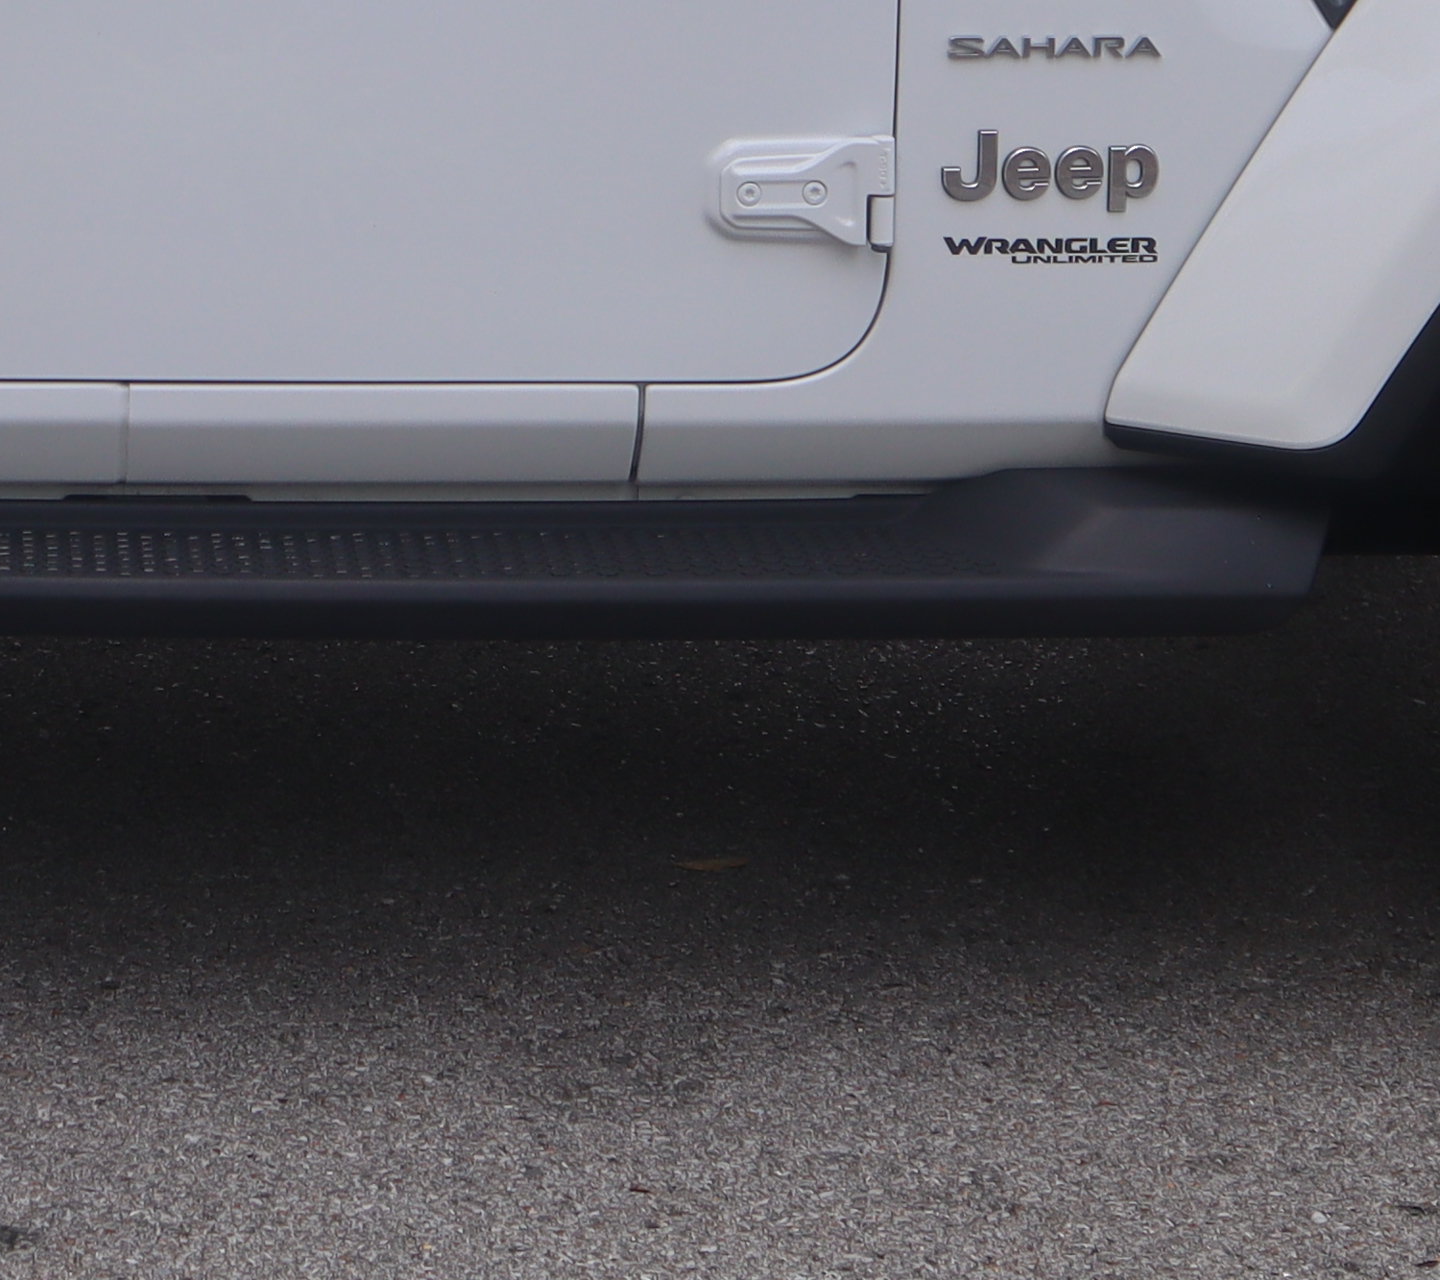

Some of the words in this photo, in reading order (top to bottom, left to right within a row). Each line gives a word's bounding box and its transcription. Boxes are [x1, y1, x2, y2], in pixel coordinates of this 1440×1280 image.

[947, 34, 1162, 60] SAHARA
[940, 128, 1160, 213] Jeep
[943, 236, 1159, 255] WRANGLER
[1011, 255, 1159, 264] UNLIMITED
